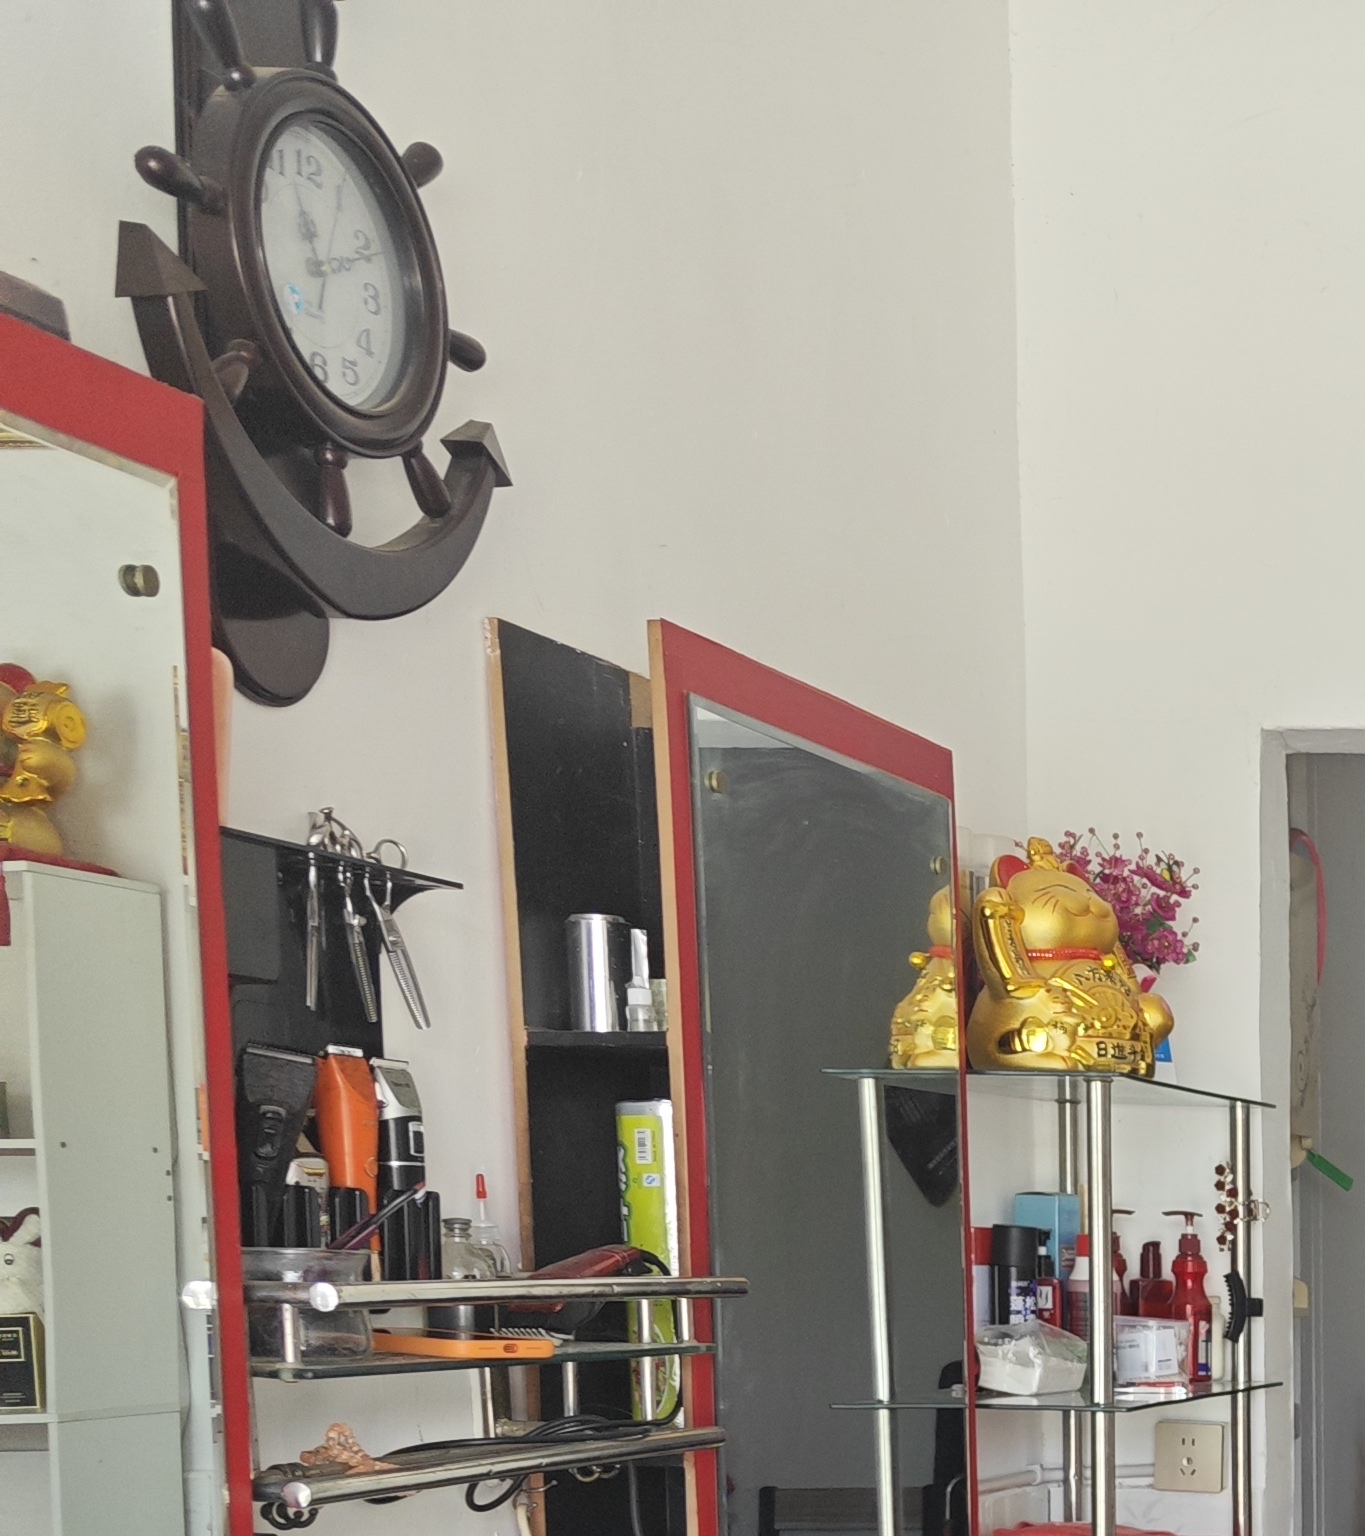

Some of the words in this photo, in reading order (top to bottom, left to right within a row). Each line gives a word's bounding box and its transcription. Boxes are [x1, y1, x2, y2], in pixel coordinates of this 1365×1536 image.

[294, 148, 323, 190] 12
[363, 282, 381, 316] 3
[357, 327, 375, 358] 4
[342, 357, 359, 386] 5
